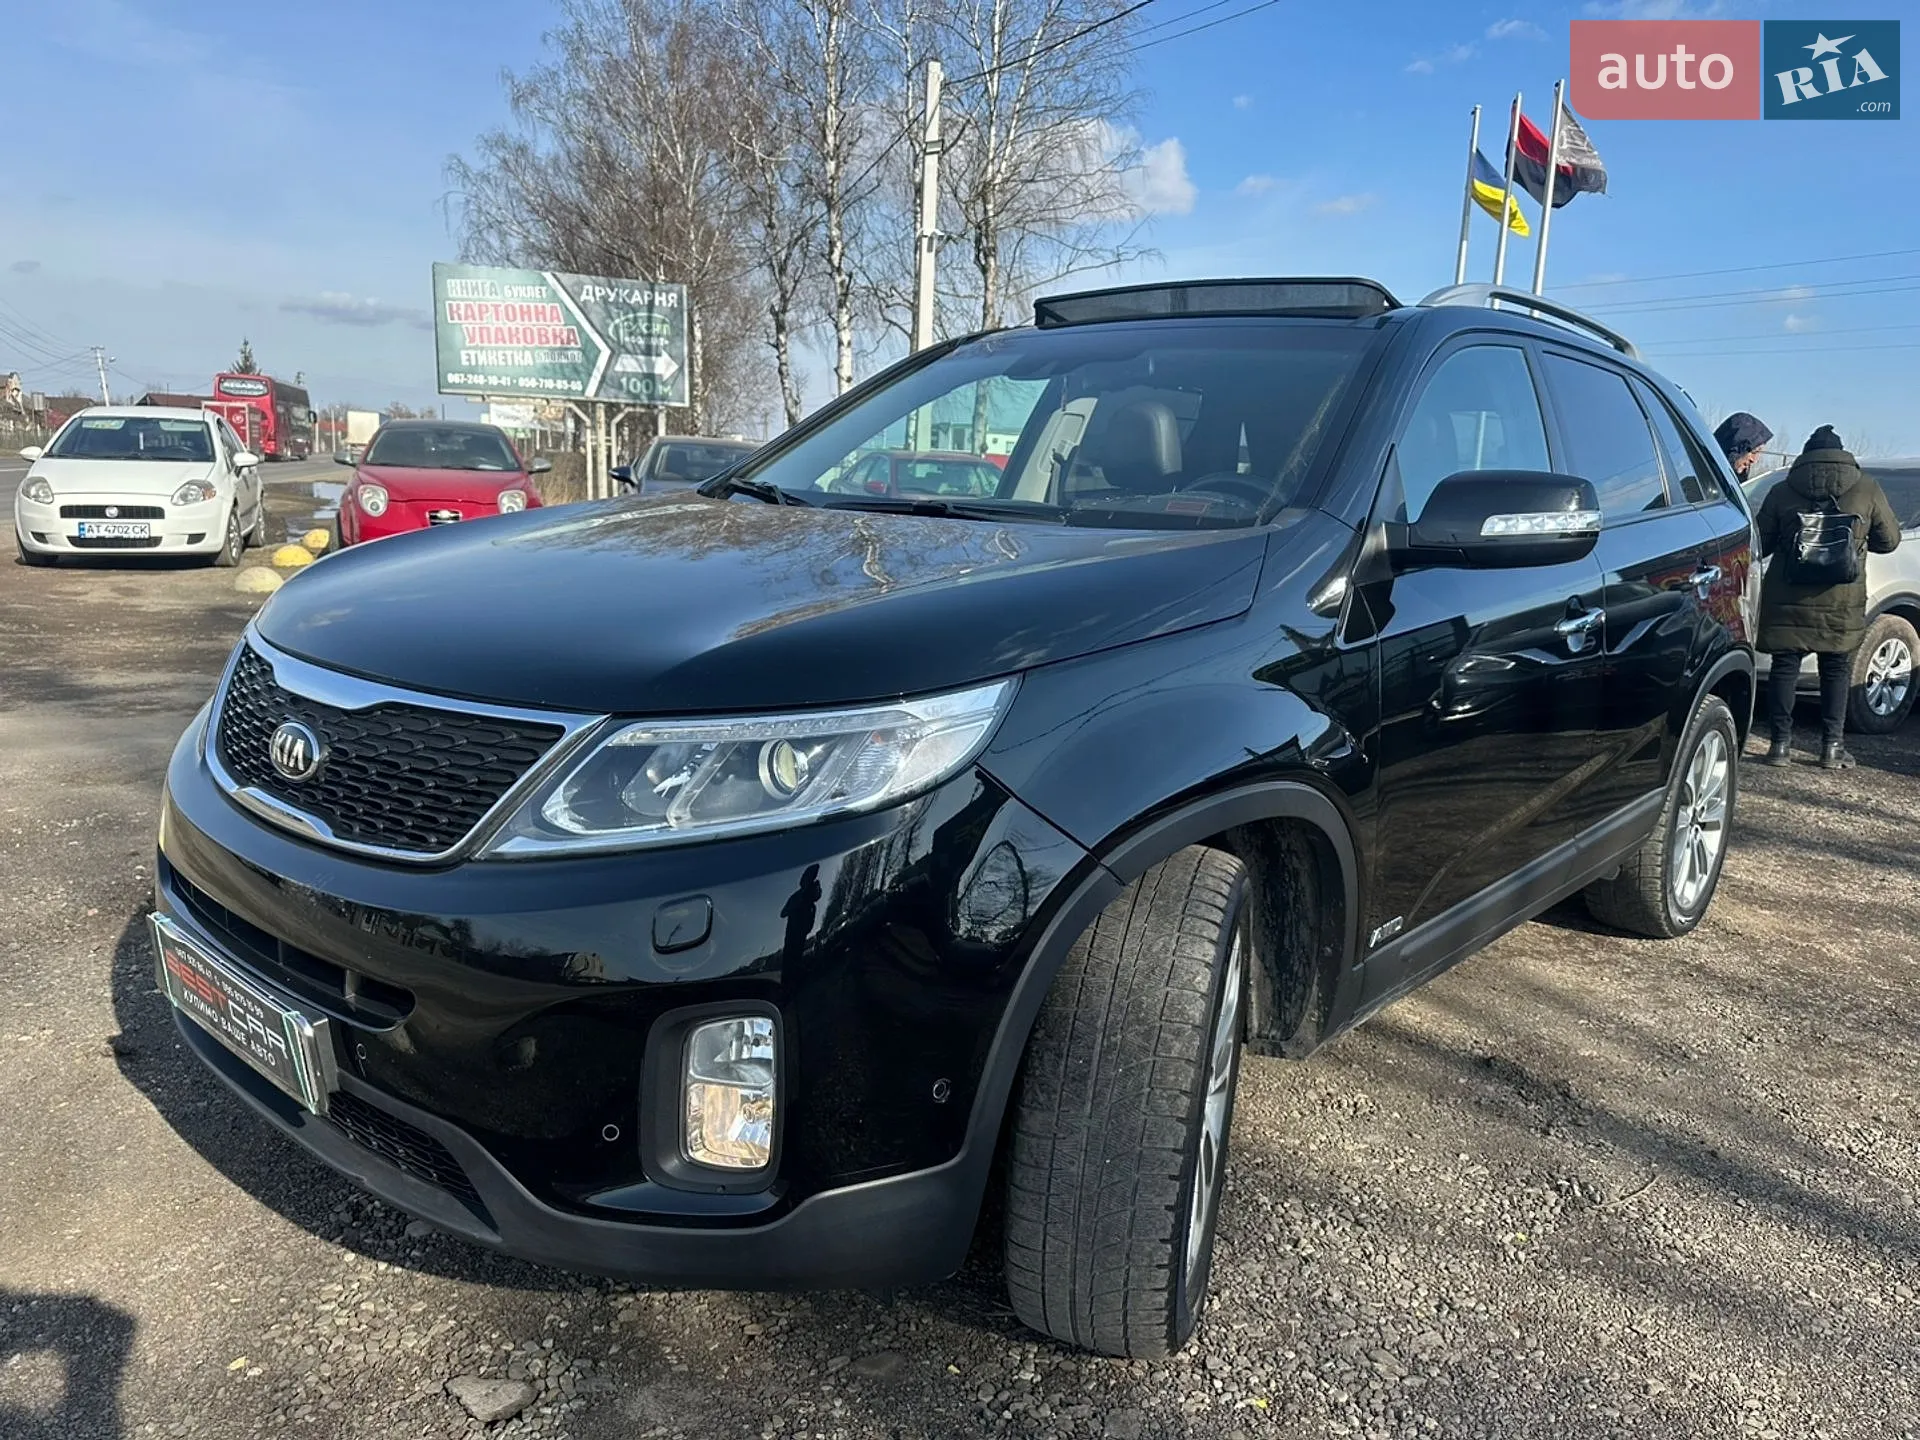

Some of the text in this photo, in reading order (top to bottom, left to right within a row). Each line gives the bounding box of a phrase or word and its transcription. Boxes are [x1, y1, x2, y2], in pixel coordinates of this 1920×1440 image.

[447, 279, 547, 299] КНИГА БУКЛЕТ
[580, 285, 678, 308] ДРУКАРНЯ
[446, 302, 564, 324] КАРТОННА
[463, 326, 581, 347] УПАКОВКА
[460, 350, 534, 366] ЕТИКЕТКА
[621, 377, 653, 394] 100
[86, 525, 148, 535] AT 4702 CK
[251, 1040, 276, 1067] АВТО
